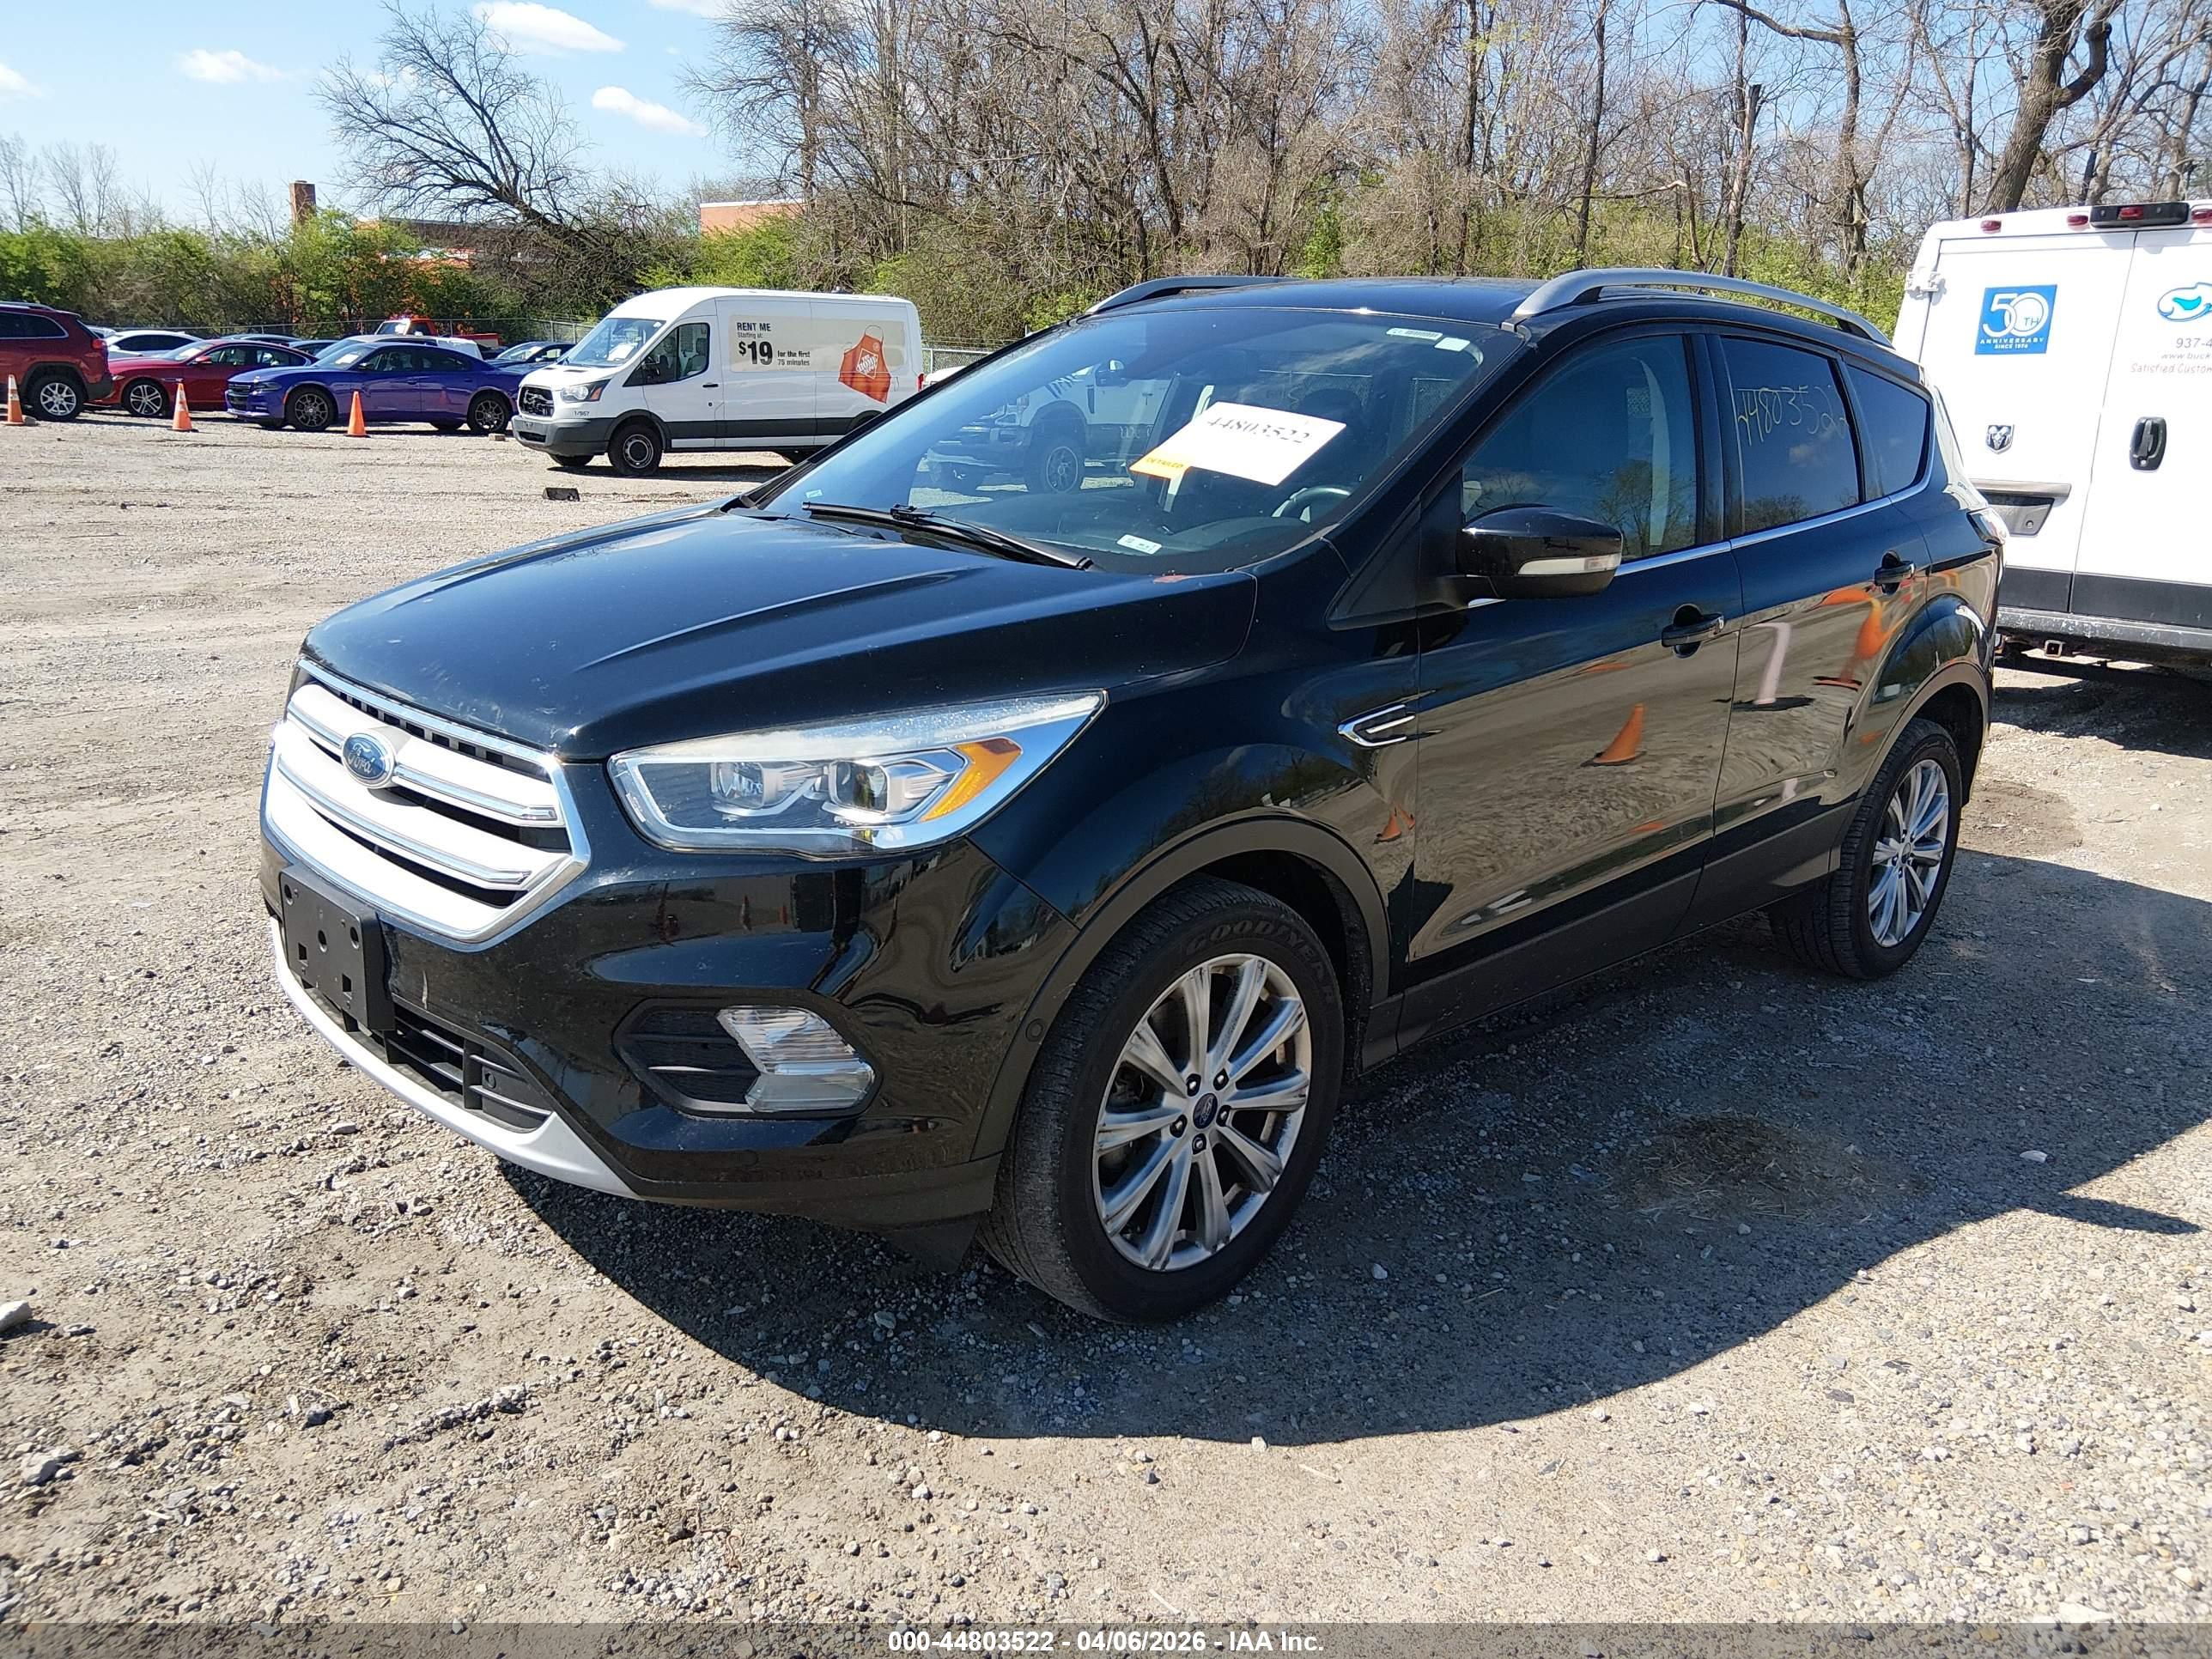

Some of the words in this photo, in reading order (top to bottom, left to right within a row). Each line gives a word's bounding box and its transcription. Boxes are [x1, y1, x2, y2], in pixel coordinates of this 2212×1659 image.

[737, 322, 757, 331] RENT
[759, 323, 771, 331] ME
[1983, 292, 2049, 337] 50
[738, 340, 774, 366] $19
[1207, 417, 1310, 444] 44803522
[348, 742, 375, 775] Ford
